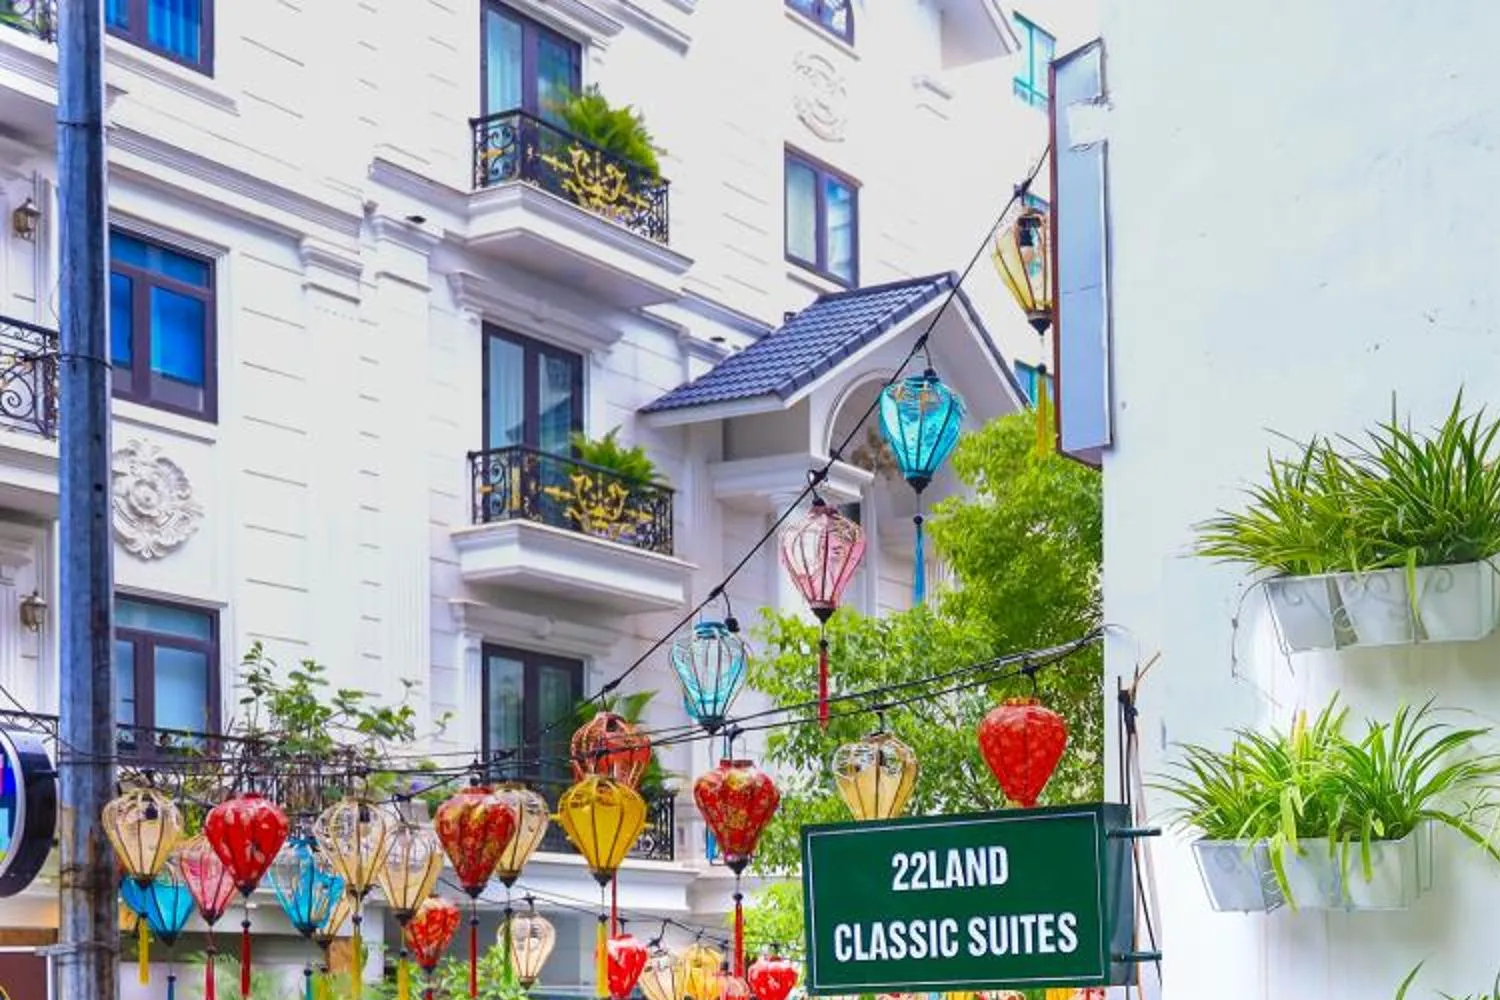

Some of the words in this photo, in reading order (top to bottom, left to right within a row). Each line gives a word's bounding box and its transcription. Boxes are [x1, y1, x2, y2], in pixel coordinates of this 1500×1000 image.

[891, 846, 1008, 891] 22LAND
[834, 918, 959, 962] CLASSIC
[968, 911, 1078, 957] SUITES
